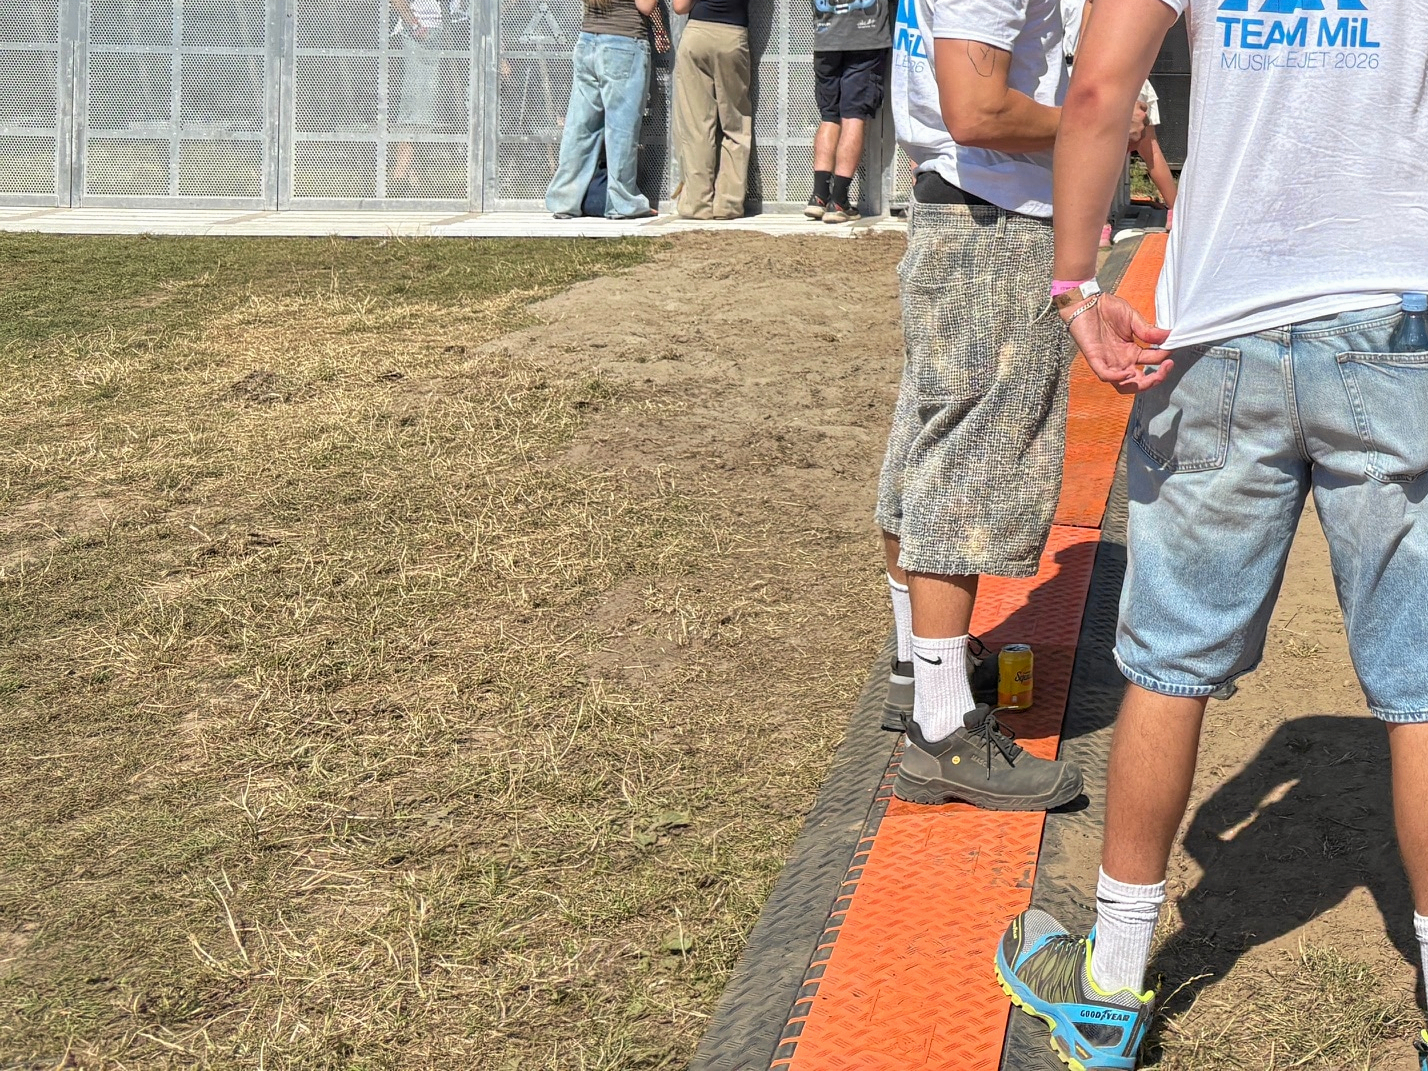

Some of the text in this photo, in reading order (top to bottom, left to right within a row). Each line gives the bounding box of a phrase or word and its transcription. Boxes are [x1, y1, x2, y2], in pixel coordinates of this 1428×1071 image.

[1215, 16, 1381, 50] TEAM MiL
[1335, 52, 1380, 69] 2026
